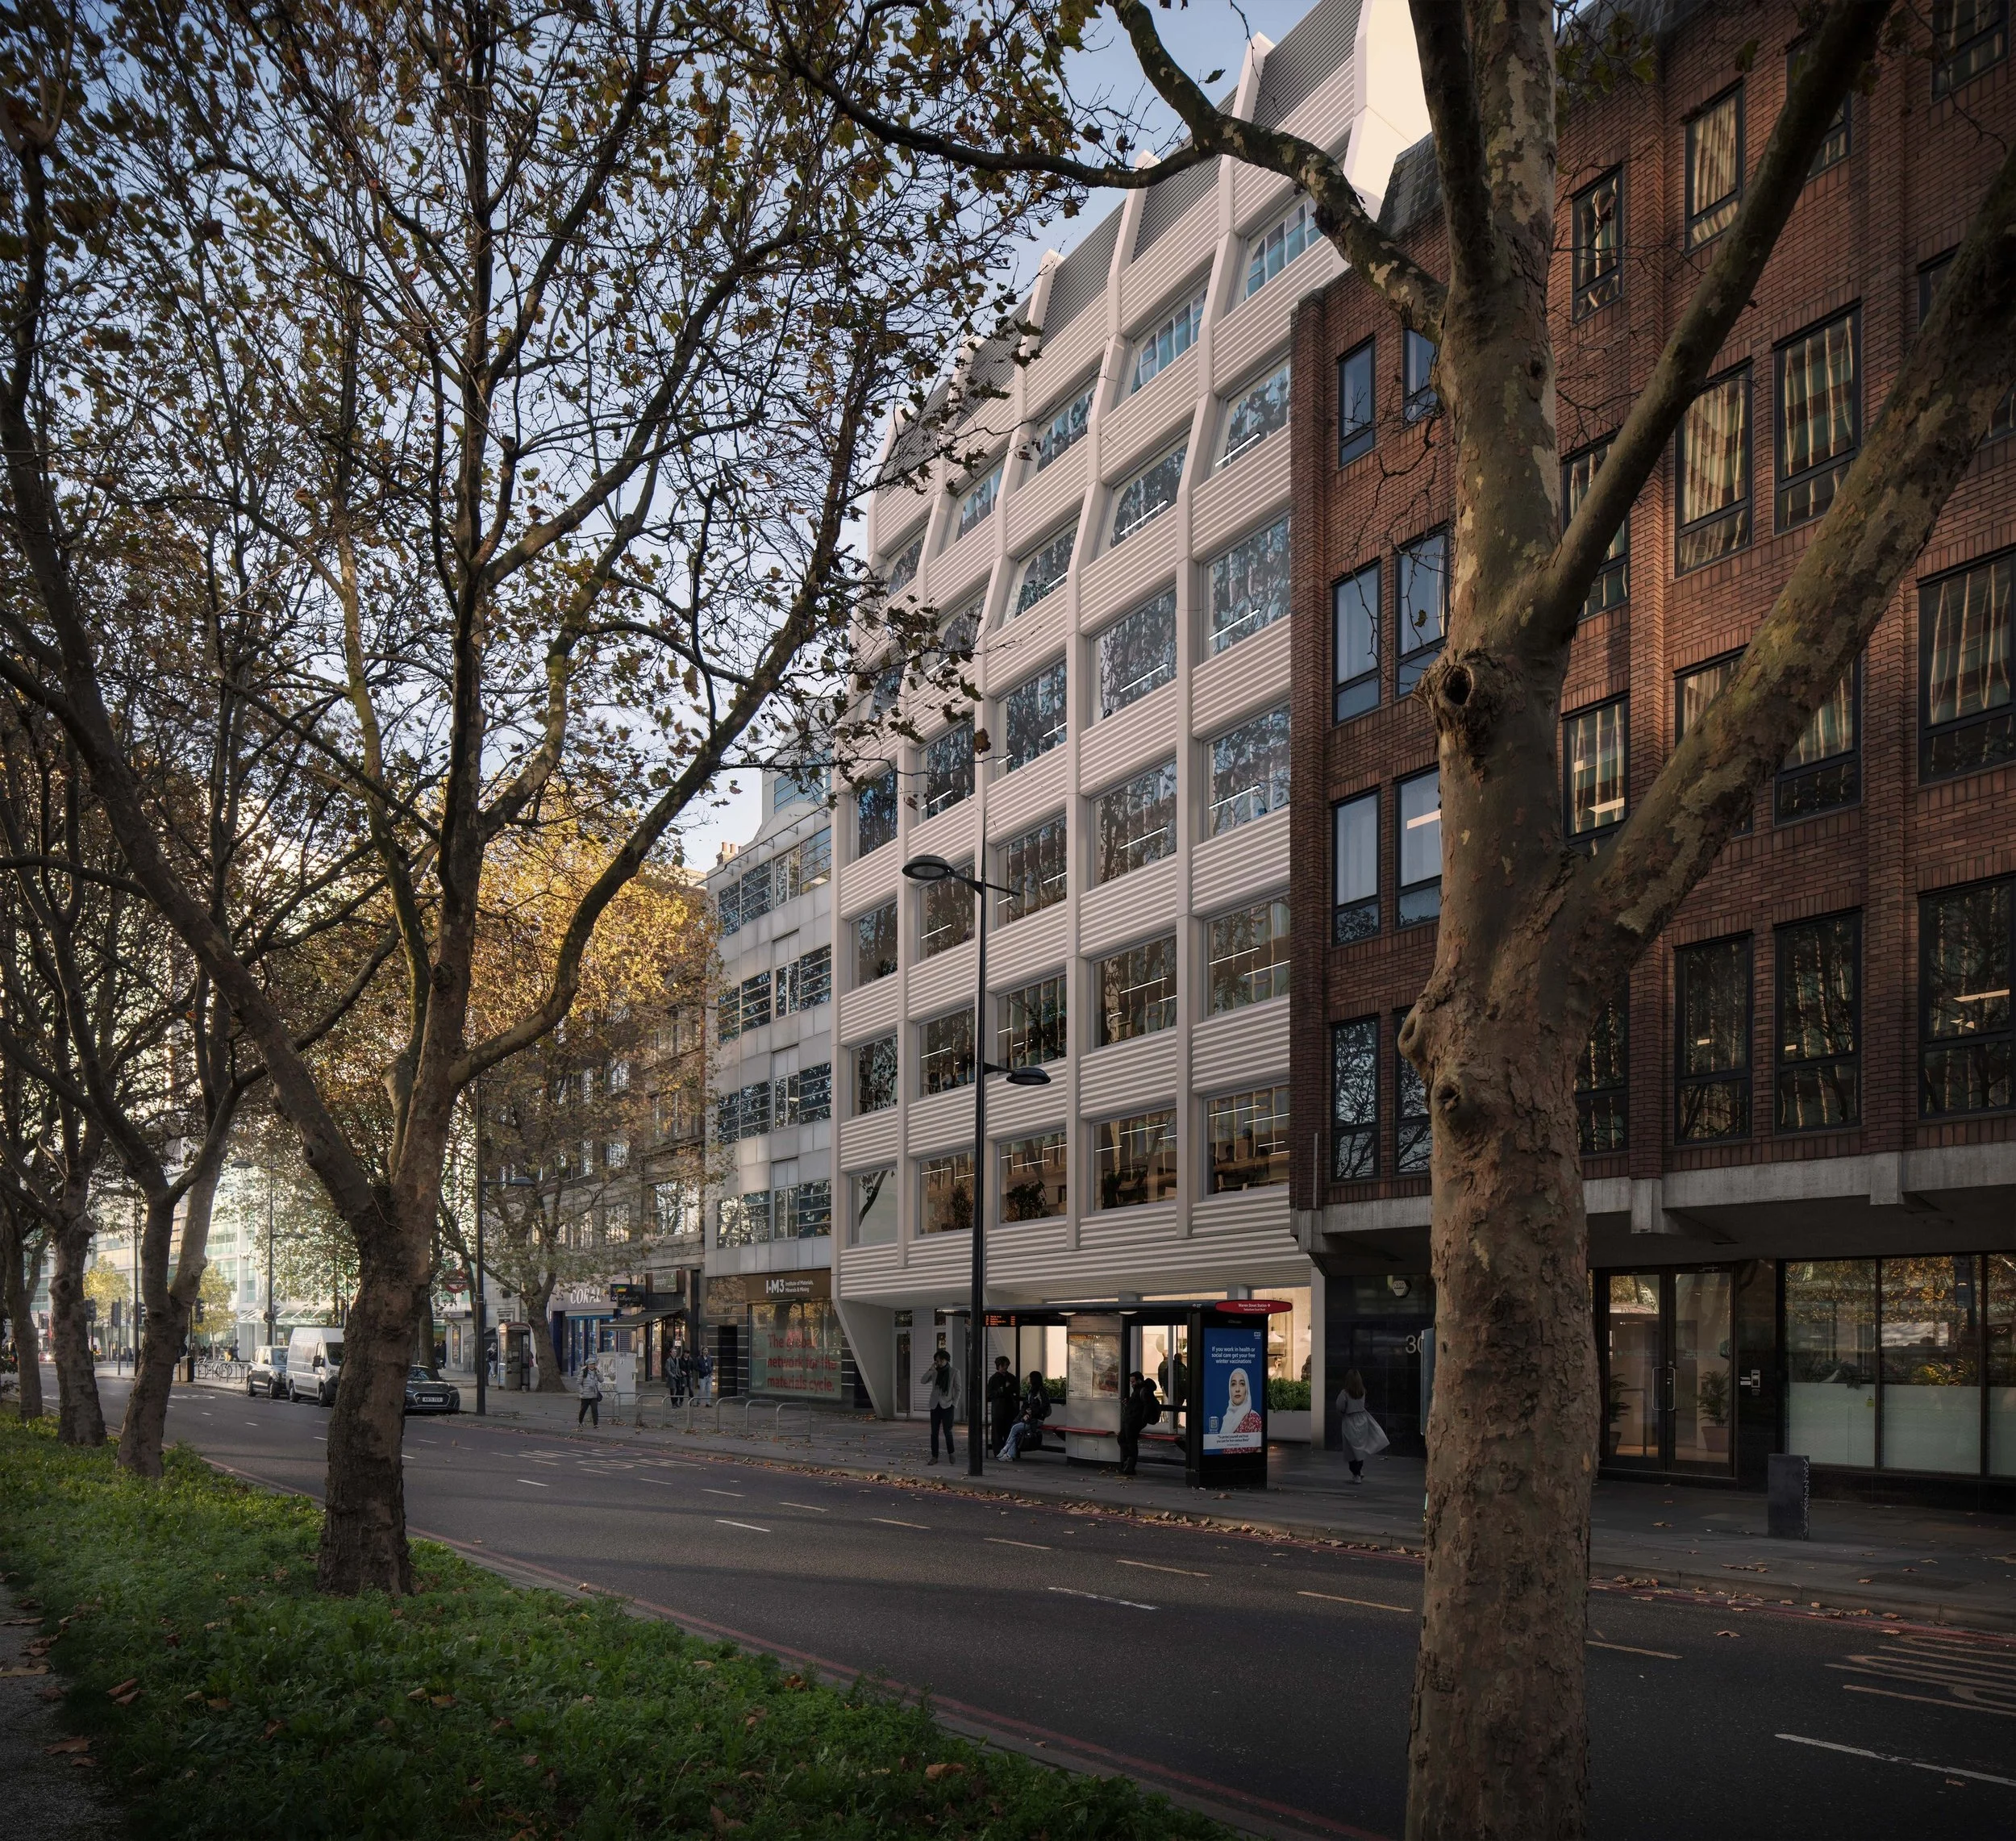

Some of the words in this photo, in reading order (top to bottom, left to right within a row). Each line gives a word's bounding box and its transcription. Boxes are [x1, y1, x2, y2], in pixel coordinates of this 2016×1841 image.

[570, 1287, 602, 1305] CORAL
[768, 1334, 784, 1348] The
[768, 1354, 802, 1368] network
[806, 1355, 818, 1369] for
[823, 1355, 836, 1370] the
[767, 1374, 806, 1389] materials
[809, 1376, 835, 1393] cycle.
[517, 1448, 643, 1459] STOP
[577, 1458, 701, 1469] BUS
